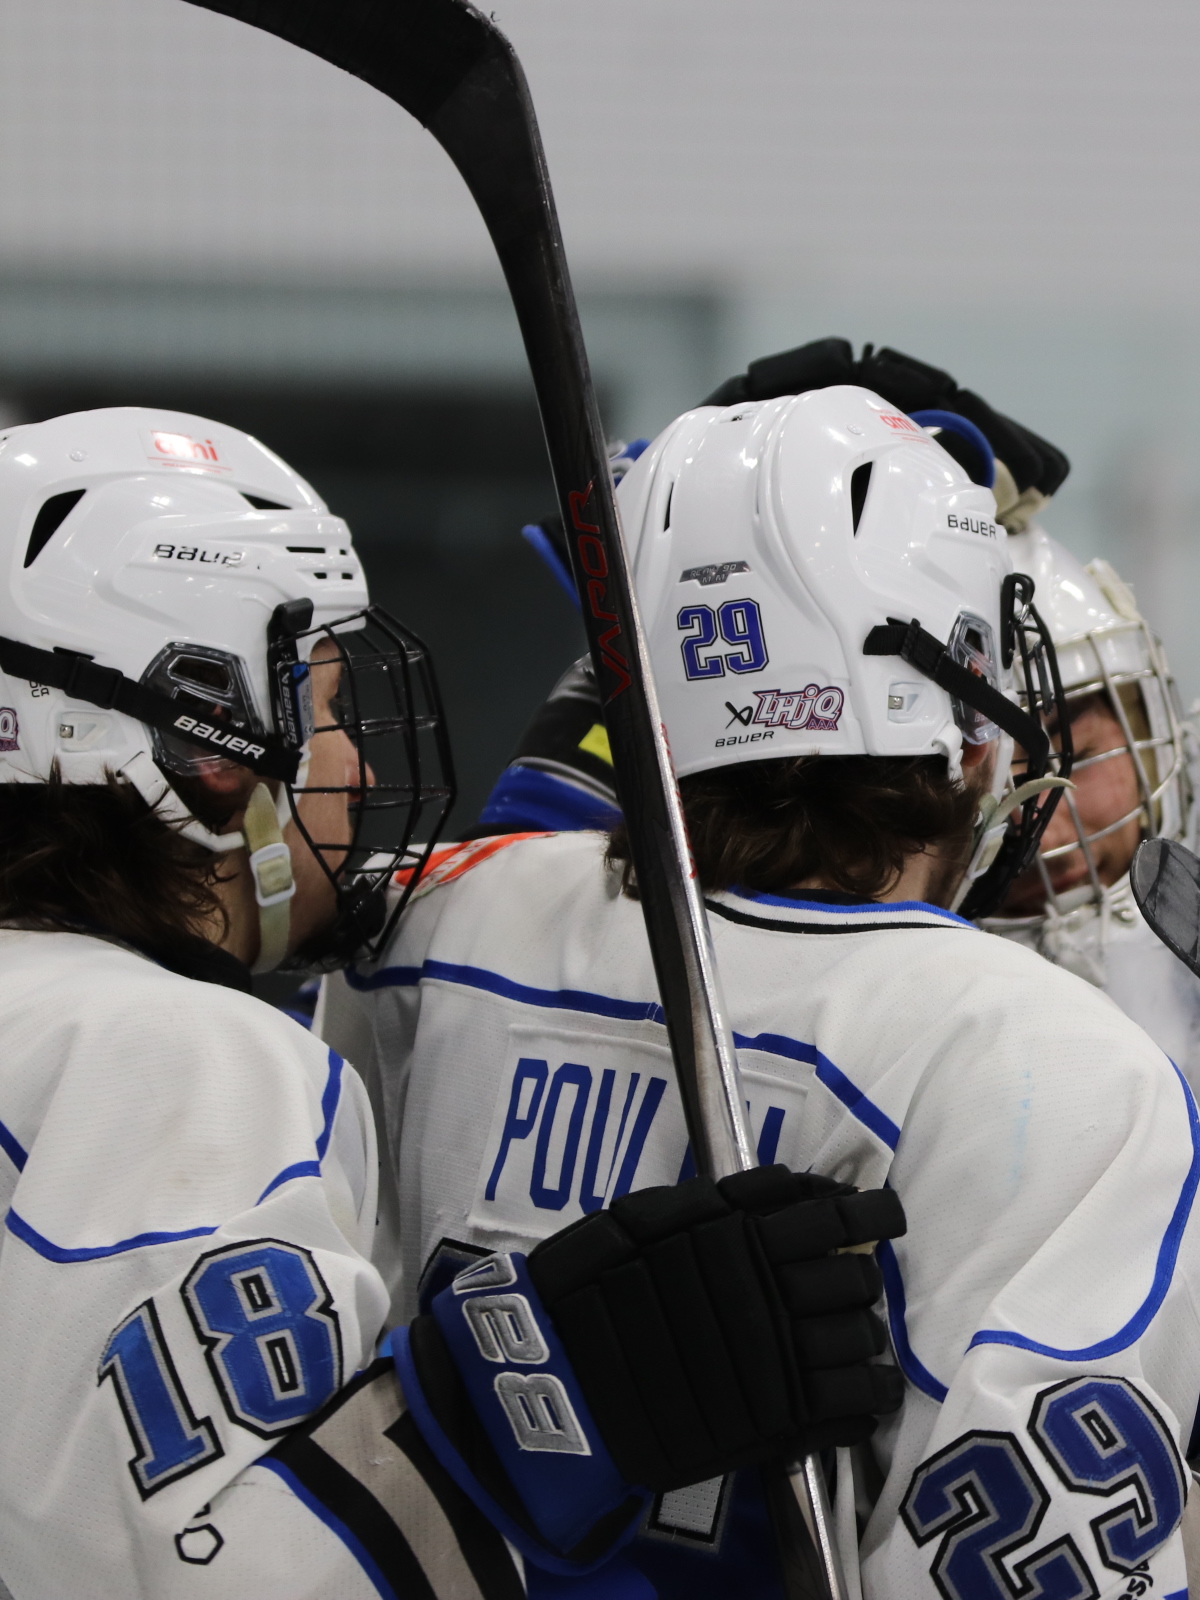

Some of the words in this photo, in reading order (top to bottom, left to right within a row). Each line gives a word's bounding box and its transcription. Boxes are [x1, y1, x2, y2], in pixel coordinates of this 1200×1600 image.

[947, 514, 997, 540] BAUER
[569, 477, 632, 704] VAPOR
[677, 598, 769, 681] 29
[173, 714, 266, 760] BAUER
[715, 730, 775, 748] BAUER
[97, 1237, 345, 1502] 18
[900, 1375, 1188, 1600] 29
